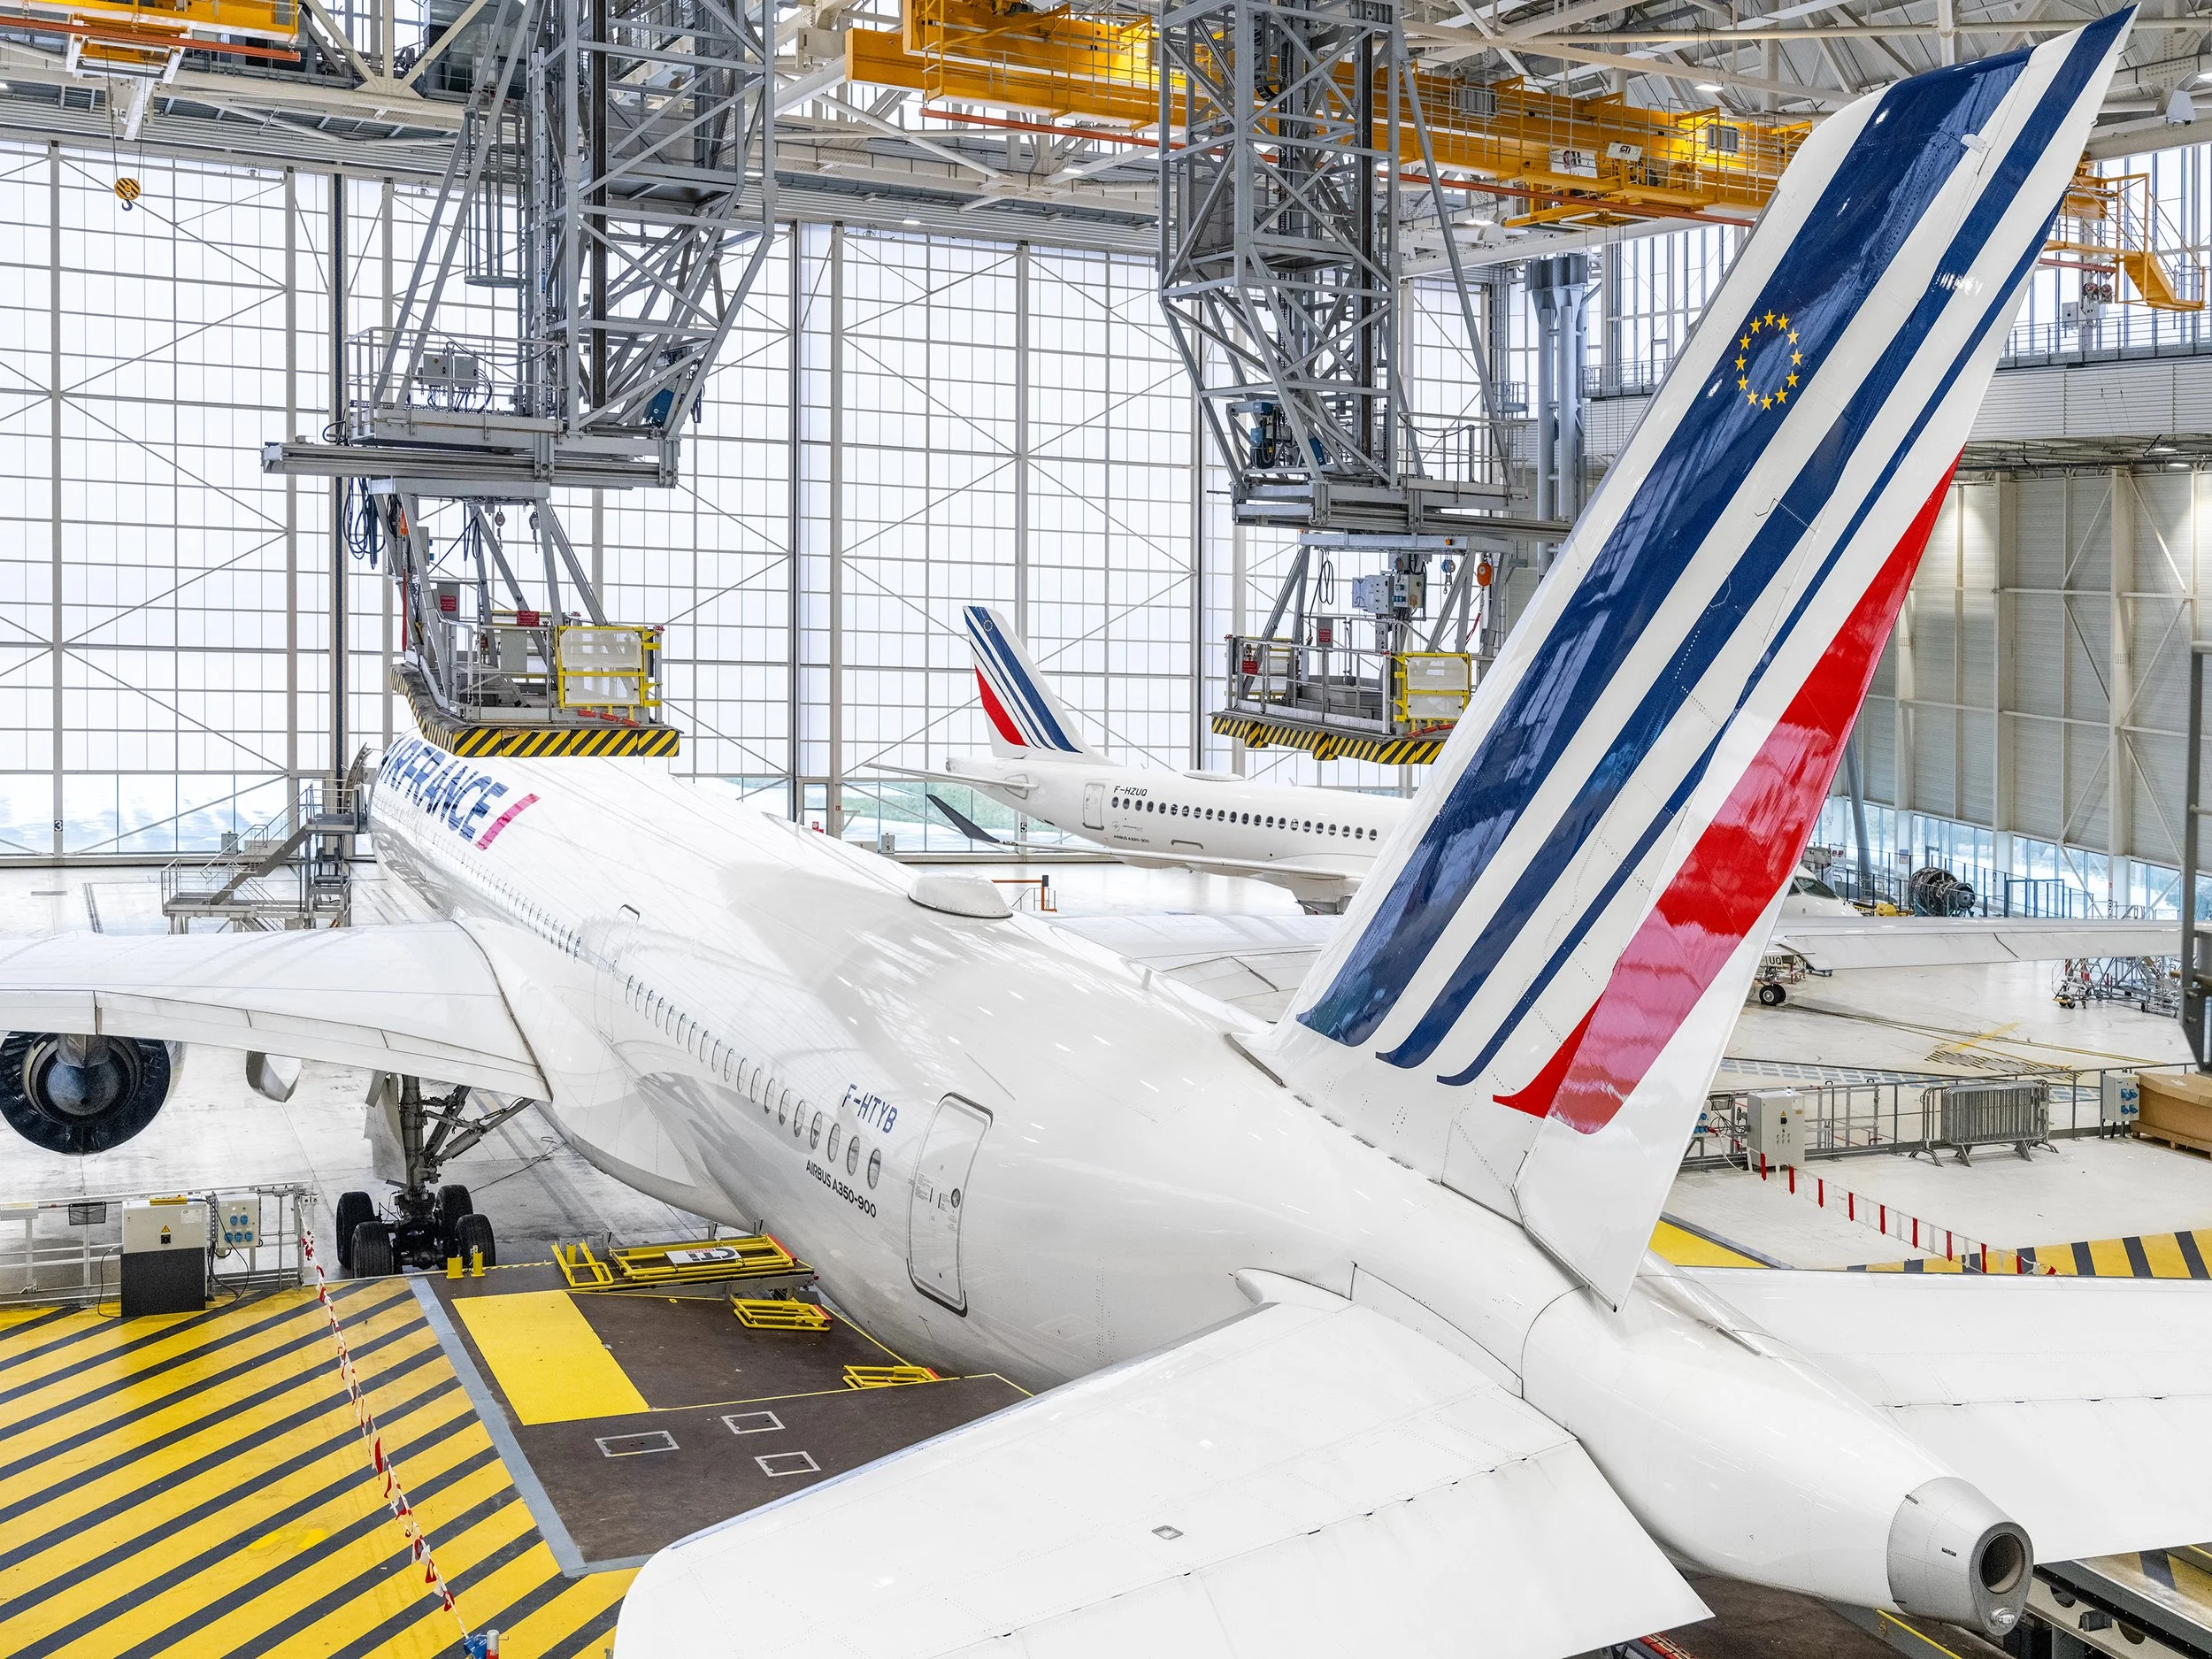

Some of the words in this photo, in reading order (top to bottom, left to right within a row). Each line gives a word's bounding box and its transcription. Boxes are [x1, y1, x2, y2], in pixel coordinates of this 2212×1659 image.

[55, 820, 62, 831] 3
[1020, 822, 1027, 833] 5
[842, 1083, 898, 1133] F-HTYB
[806, 1159, 832, 1187] AIRBUS
[832, 1179, 877, 1217] A350-900
